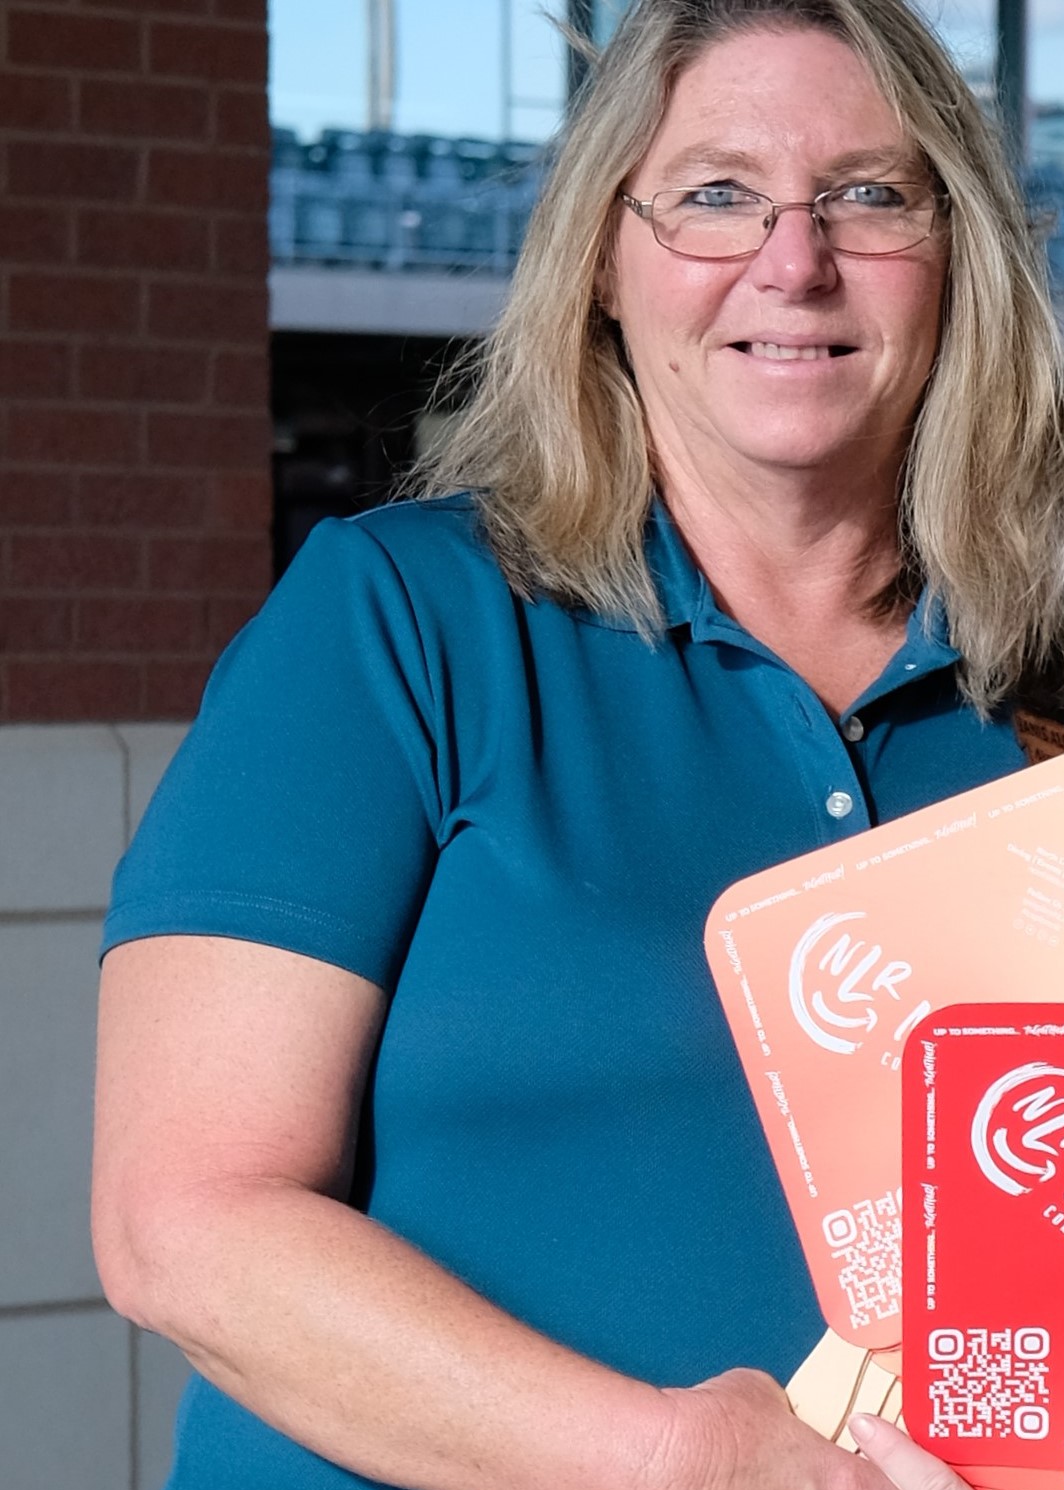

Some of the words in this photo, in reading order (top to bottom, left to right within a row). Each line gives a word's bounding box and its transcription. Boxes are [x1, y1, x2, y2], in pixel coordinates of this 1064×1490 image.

[818, 934, 912, 1001] NLR
[756, 1029, 766, 1042] TO
[933, 1028, 947, 1036] UP
[761, 1043, 771, 1056] UP
[927, 1143, 935, 1155] TO
[927, 1156, 935, 1169] UP
[804, 1171, 814, 1184] TO
[808, 1183, 818, 1198] UP
[927, 1284, 935, 1296] TO
[927, 1298, 935, 1310] UP
